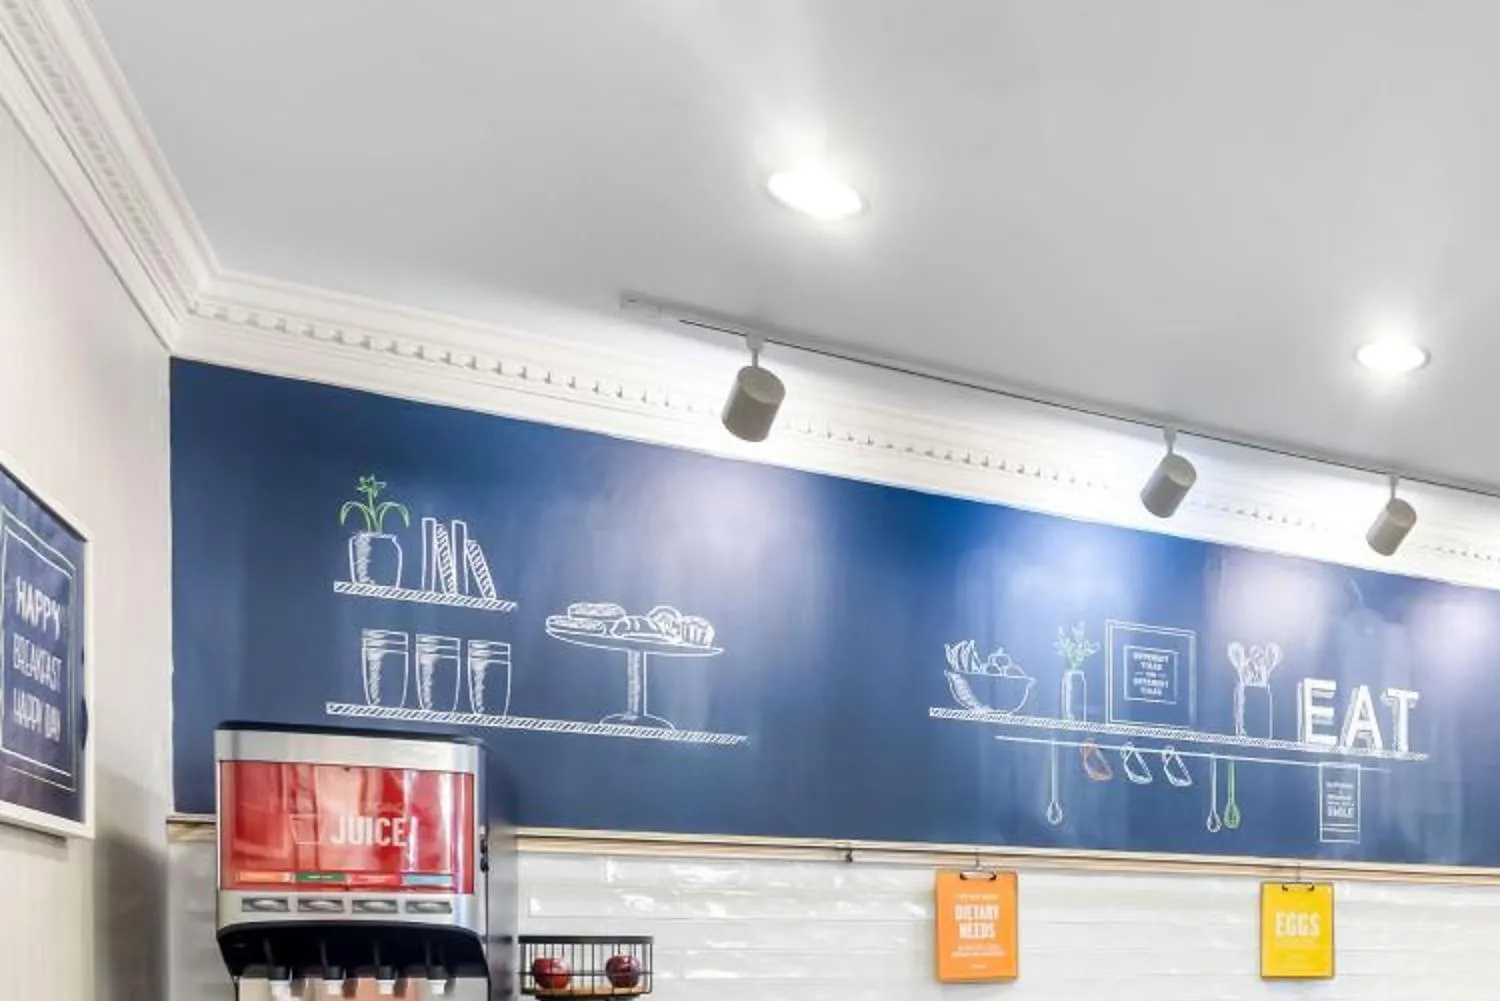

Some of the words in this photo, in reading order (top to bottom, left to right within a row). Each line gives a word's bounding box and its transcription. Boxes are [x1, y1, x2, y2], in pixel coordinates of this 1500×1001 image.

[16, 575, 61, 640] HAPPY
[1298, 678, 1419, 752] EAT
[330, 815, 407, 848] JUICE
[955, 904, 999, 921] DIETARY
[1276, 911, 1320, 937] EGGS
[960, 922, 996, 939] NEEDS
